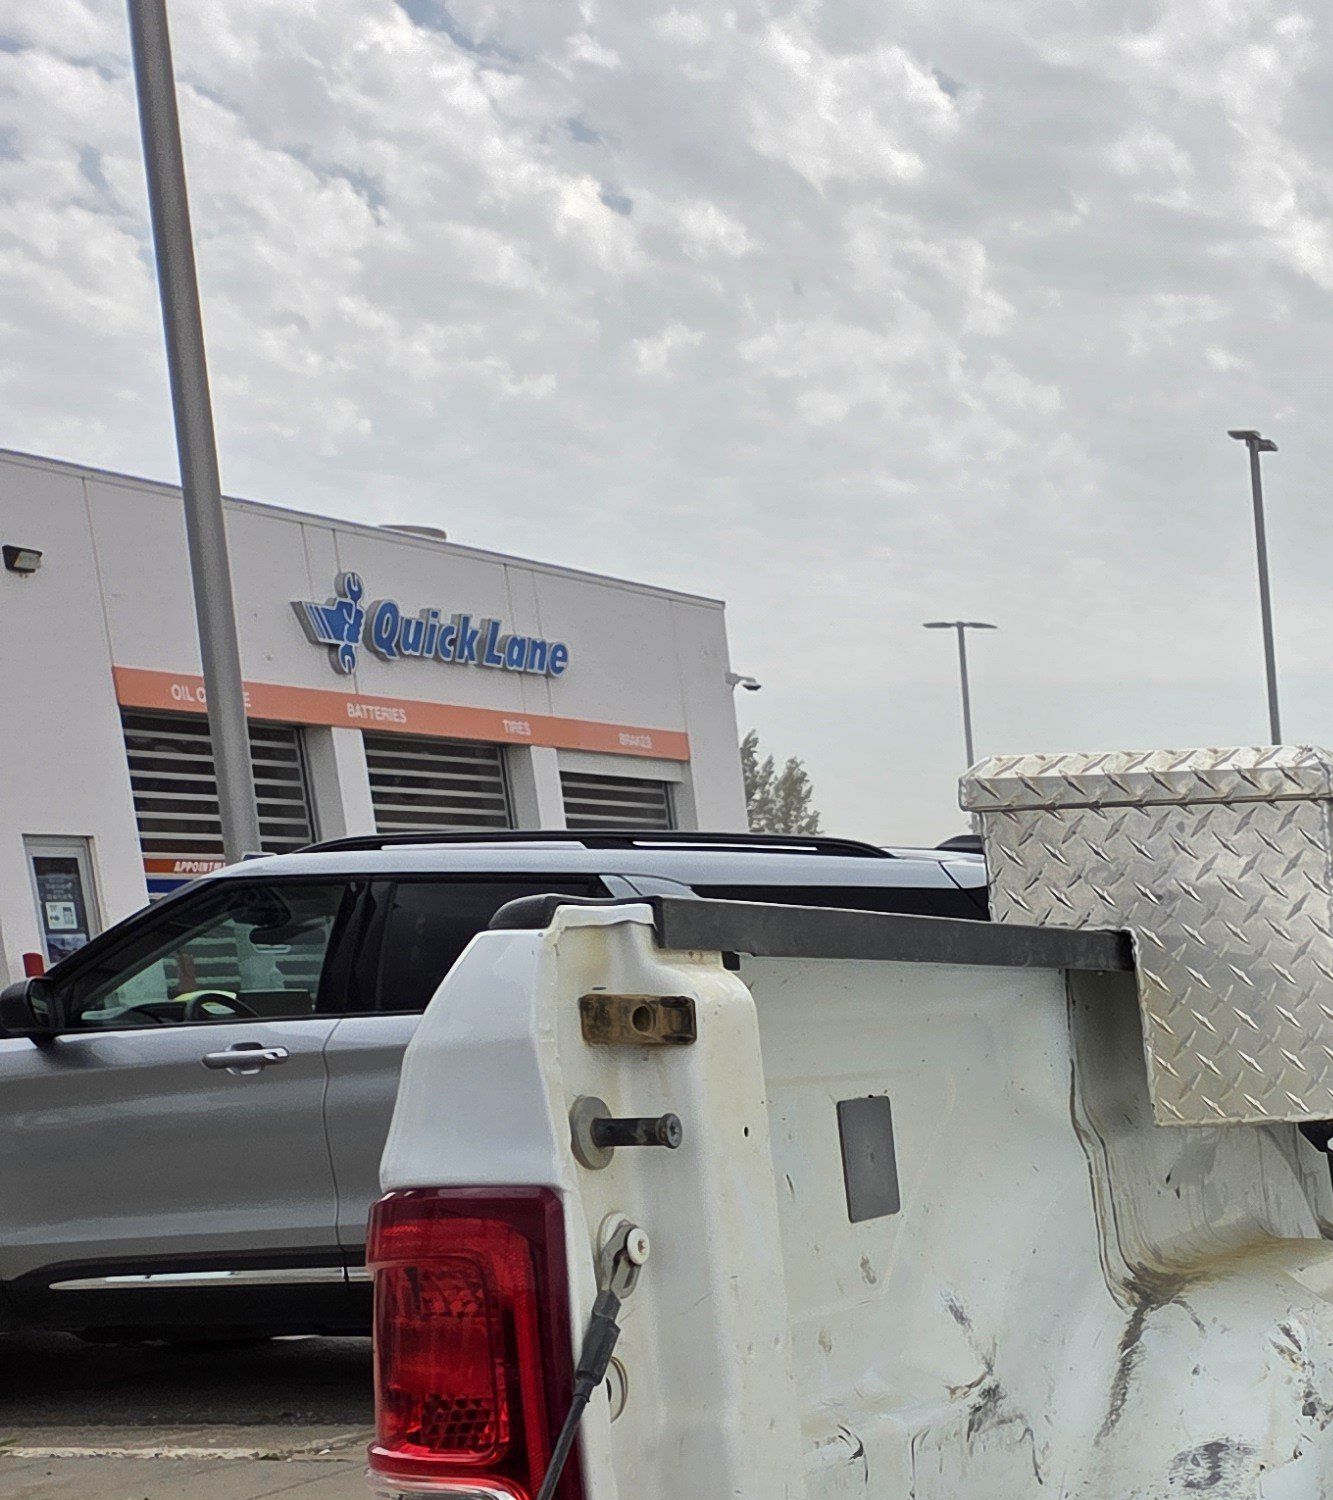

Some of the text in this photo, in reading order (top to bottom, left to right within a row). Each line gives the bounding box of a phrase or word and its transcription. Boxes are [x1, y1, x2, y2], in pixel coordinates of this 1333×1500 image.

[371, 599, 569, 677] Quick Lane
[171, 684, 195, 702] OIL
[346, 702, 407, 724] BATTERIES
